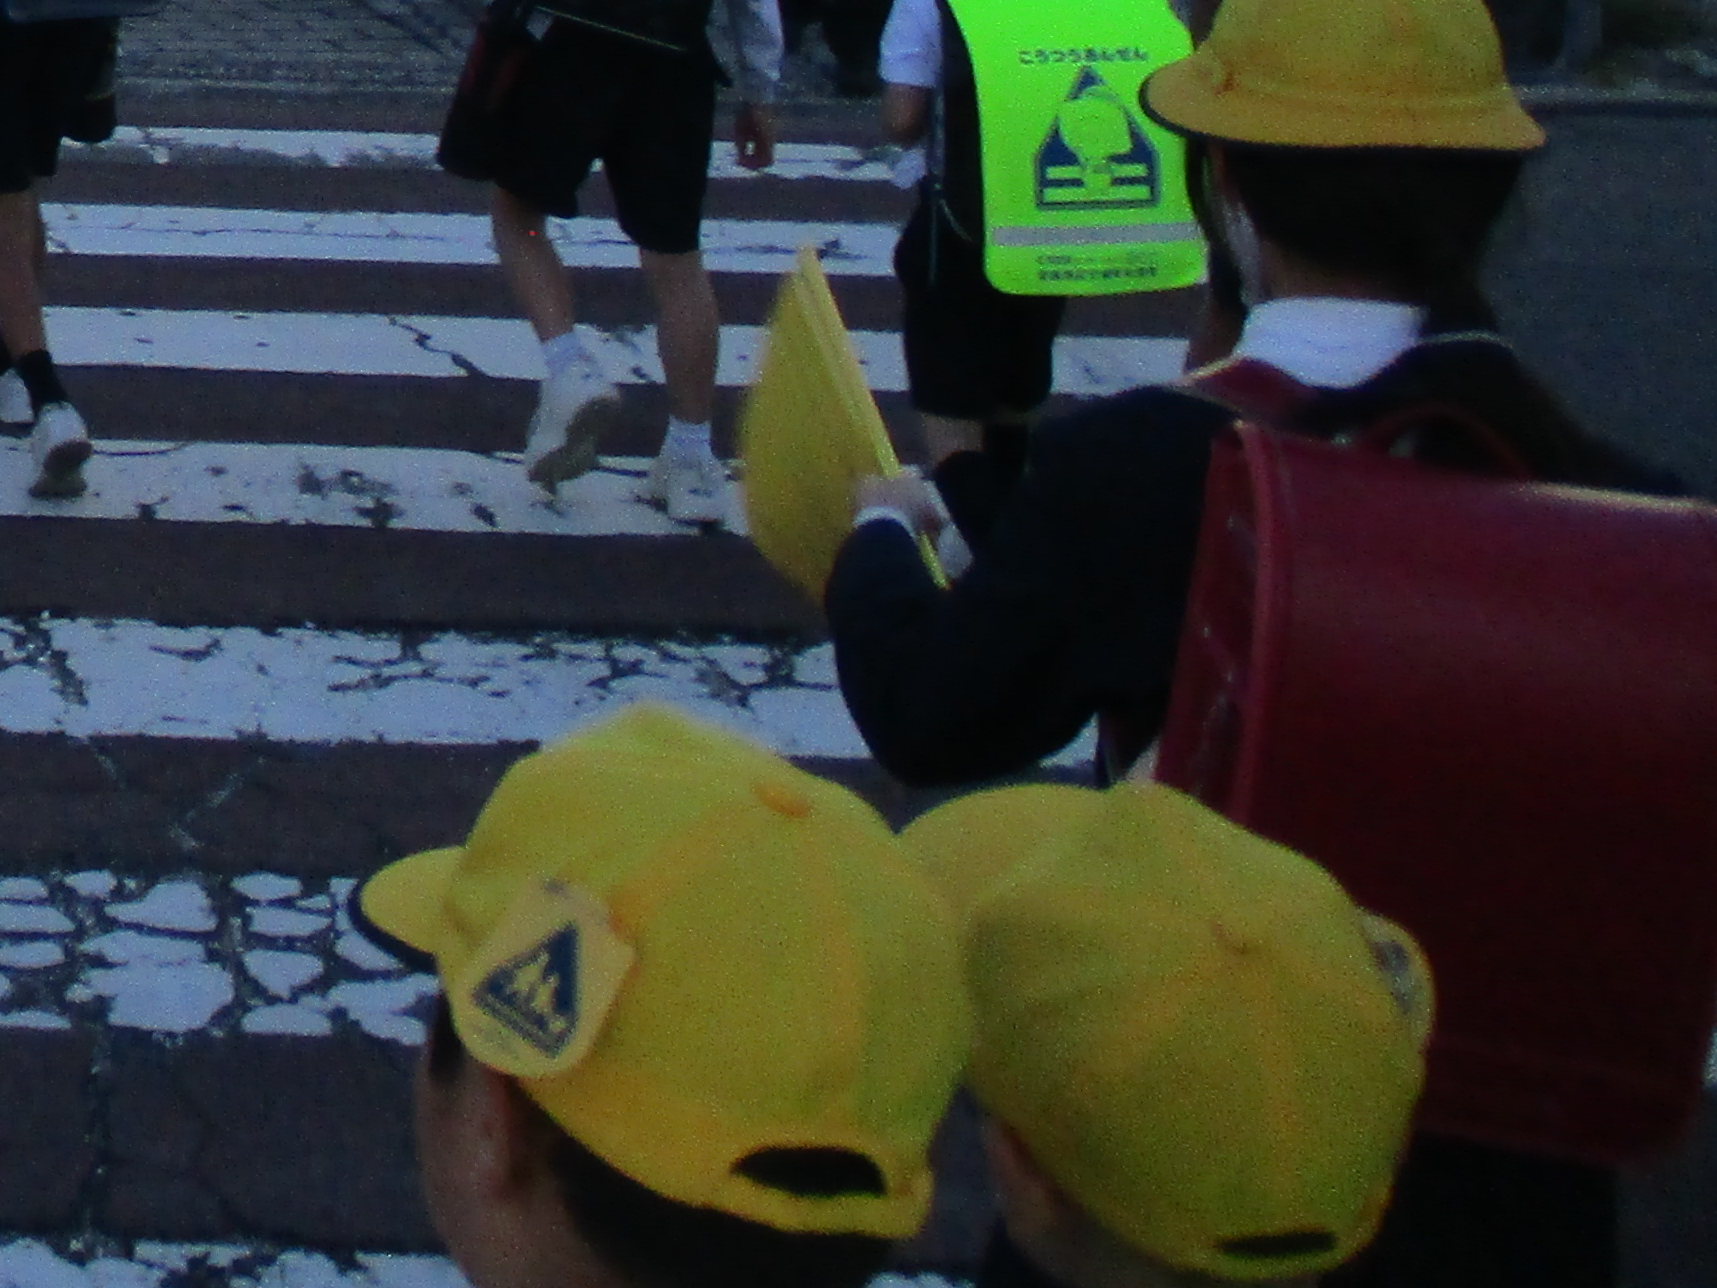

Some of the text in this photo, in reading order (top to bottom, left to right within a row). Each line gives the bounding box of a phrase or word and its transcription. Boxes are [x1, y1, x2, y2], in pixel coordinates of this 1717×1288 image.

[1018, 46, 1149, 65] こうつうあんぜん
